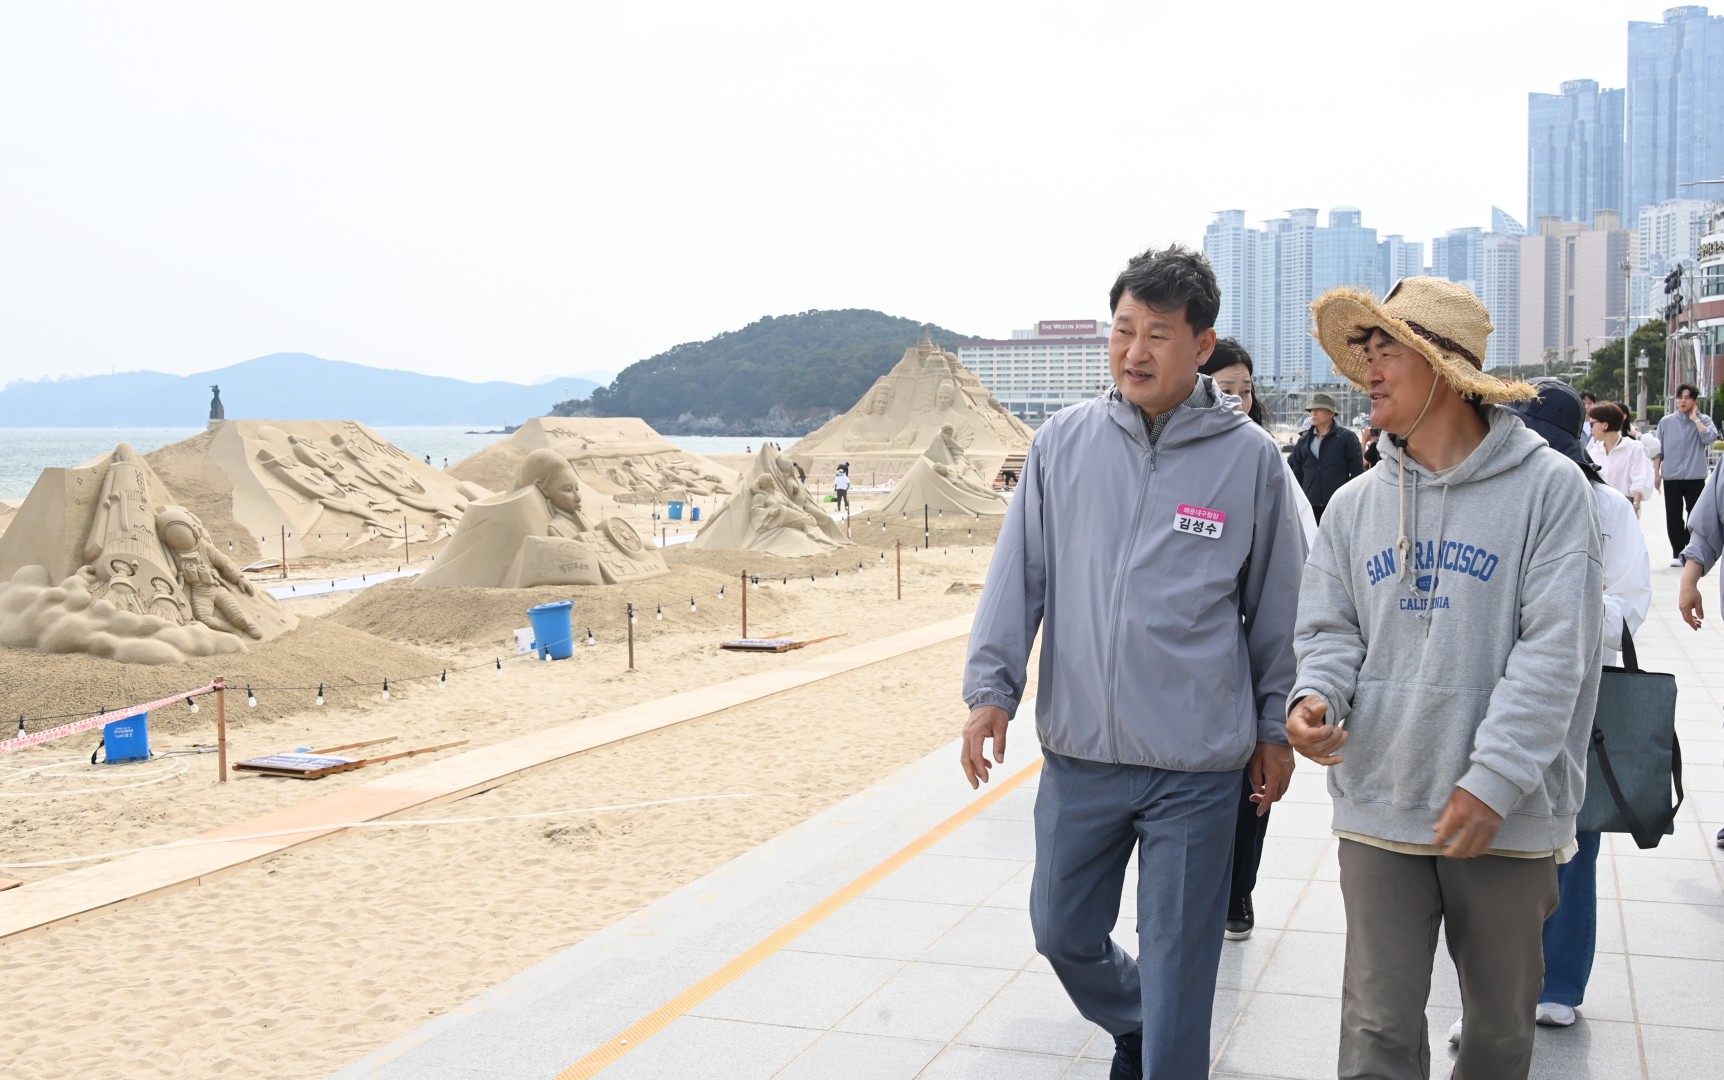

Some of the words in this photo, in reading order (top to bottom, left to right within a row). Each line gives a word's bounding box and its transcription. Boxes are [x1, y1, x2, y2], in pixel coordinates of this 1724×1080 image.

[1183, 507, 1219, 520] 해운대구청장
[1180, 517, 1217, 535] 김성수
[1366, 547, 1396, 586] SAN
[1405, 540, 1499, 582] RANCISCO
[1400, 596, 1449, 611] CALIFNIA
